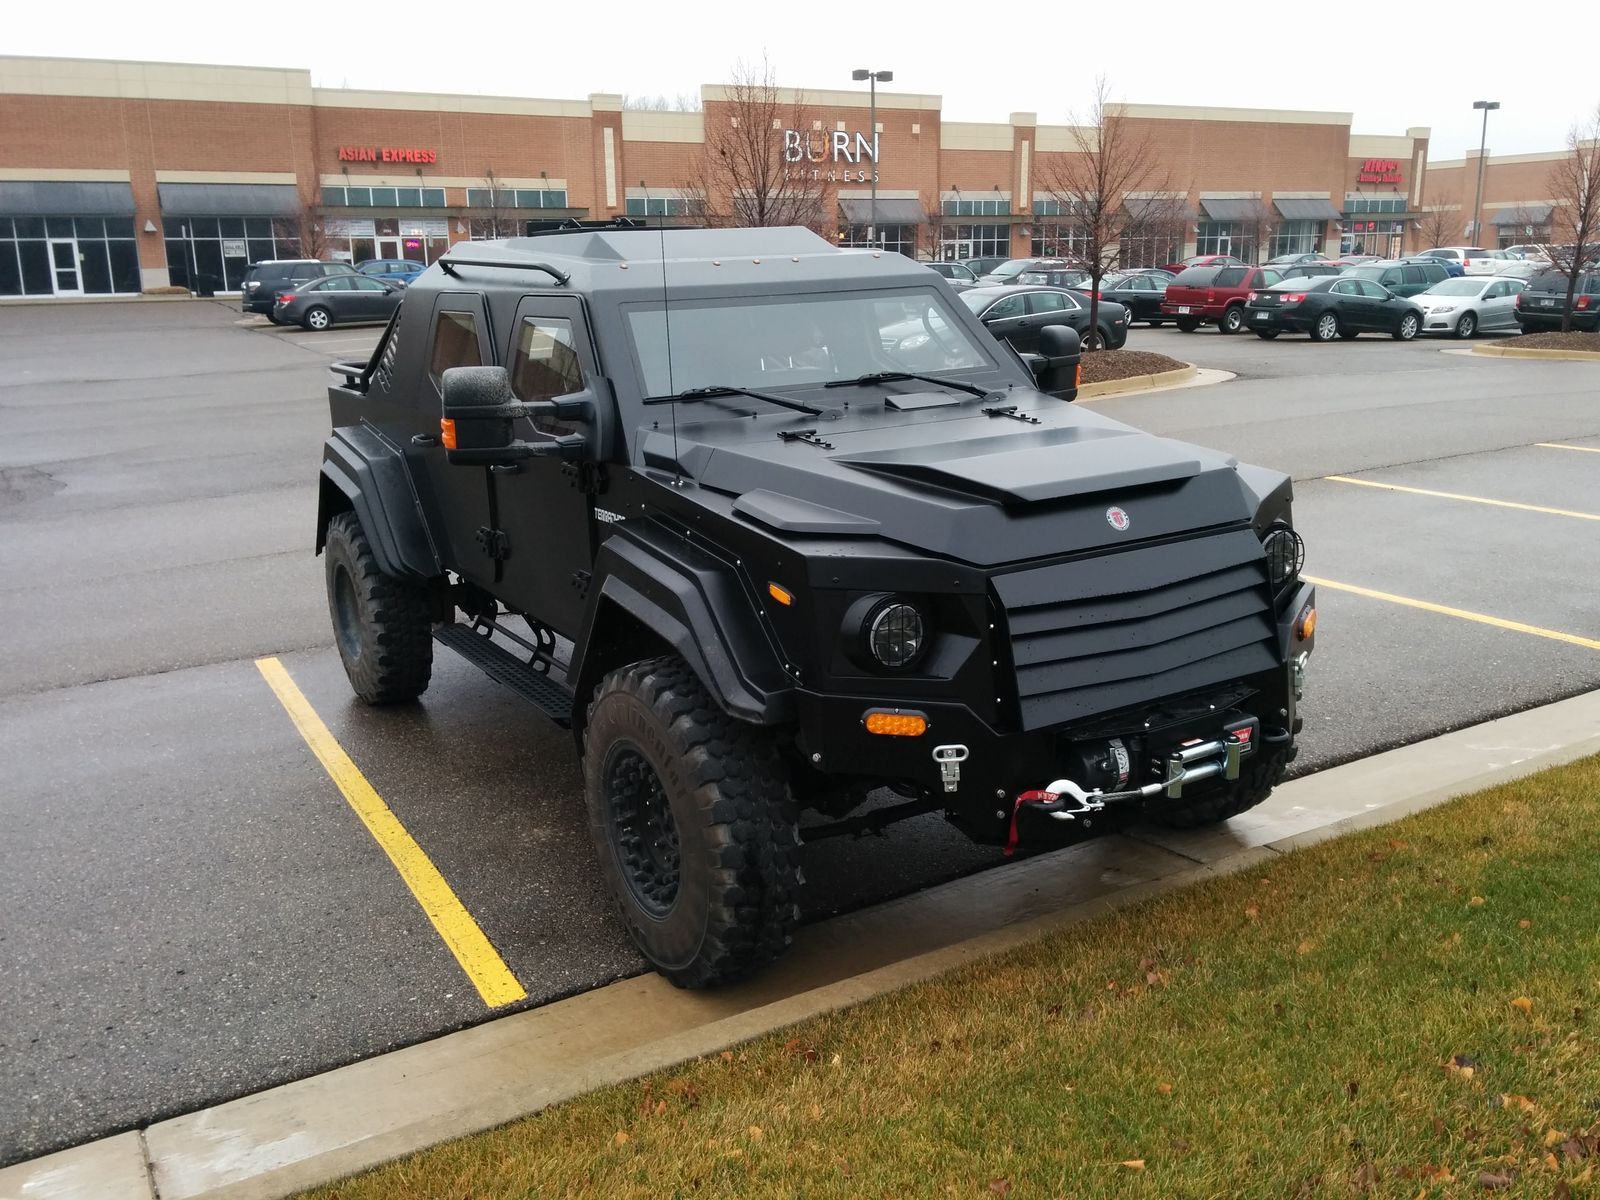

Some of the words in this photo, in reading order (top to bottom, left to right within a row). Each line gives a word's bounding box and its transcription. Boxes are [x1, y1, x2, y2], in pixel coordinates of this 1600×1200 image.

[338, 147, 376, 161] ASIAN
[383, 149, 437, 163] EXPRESS
[785, 128, 879, 163] BURN
